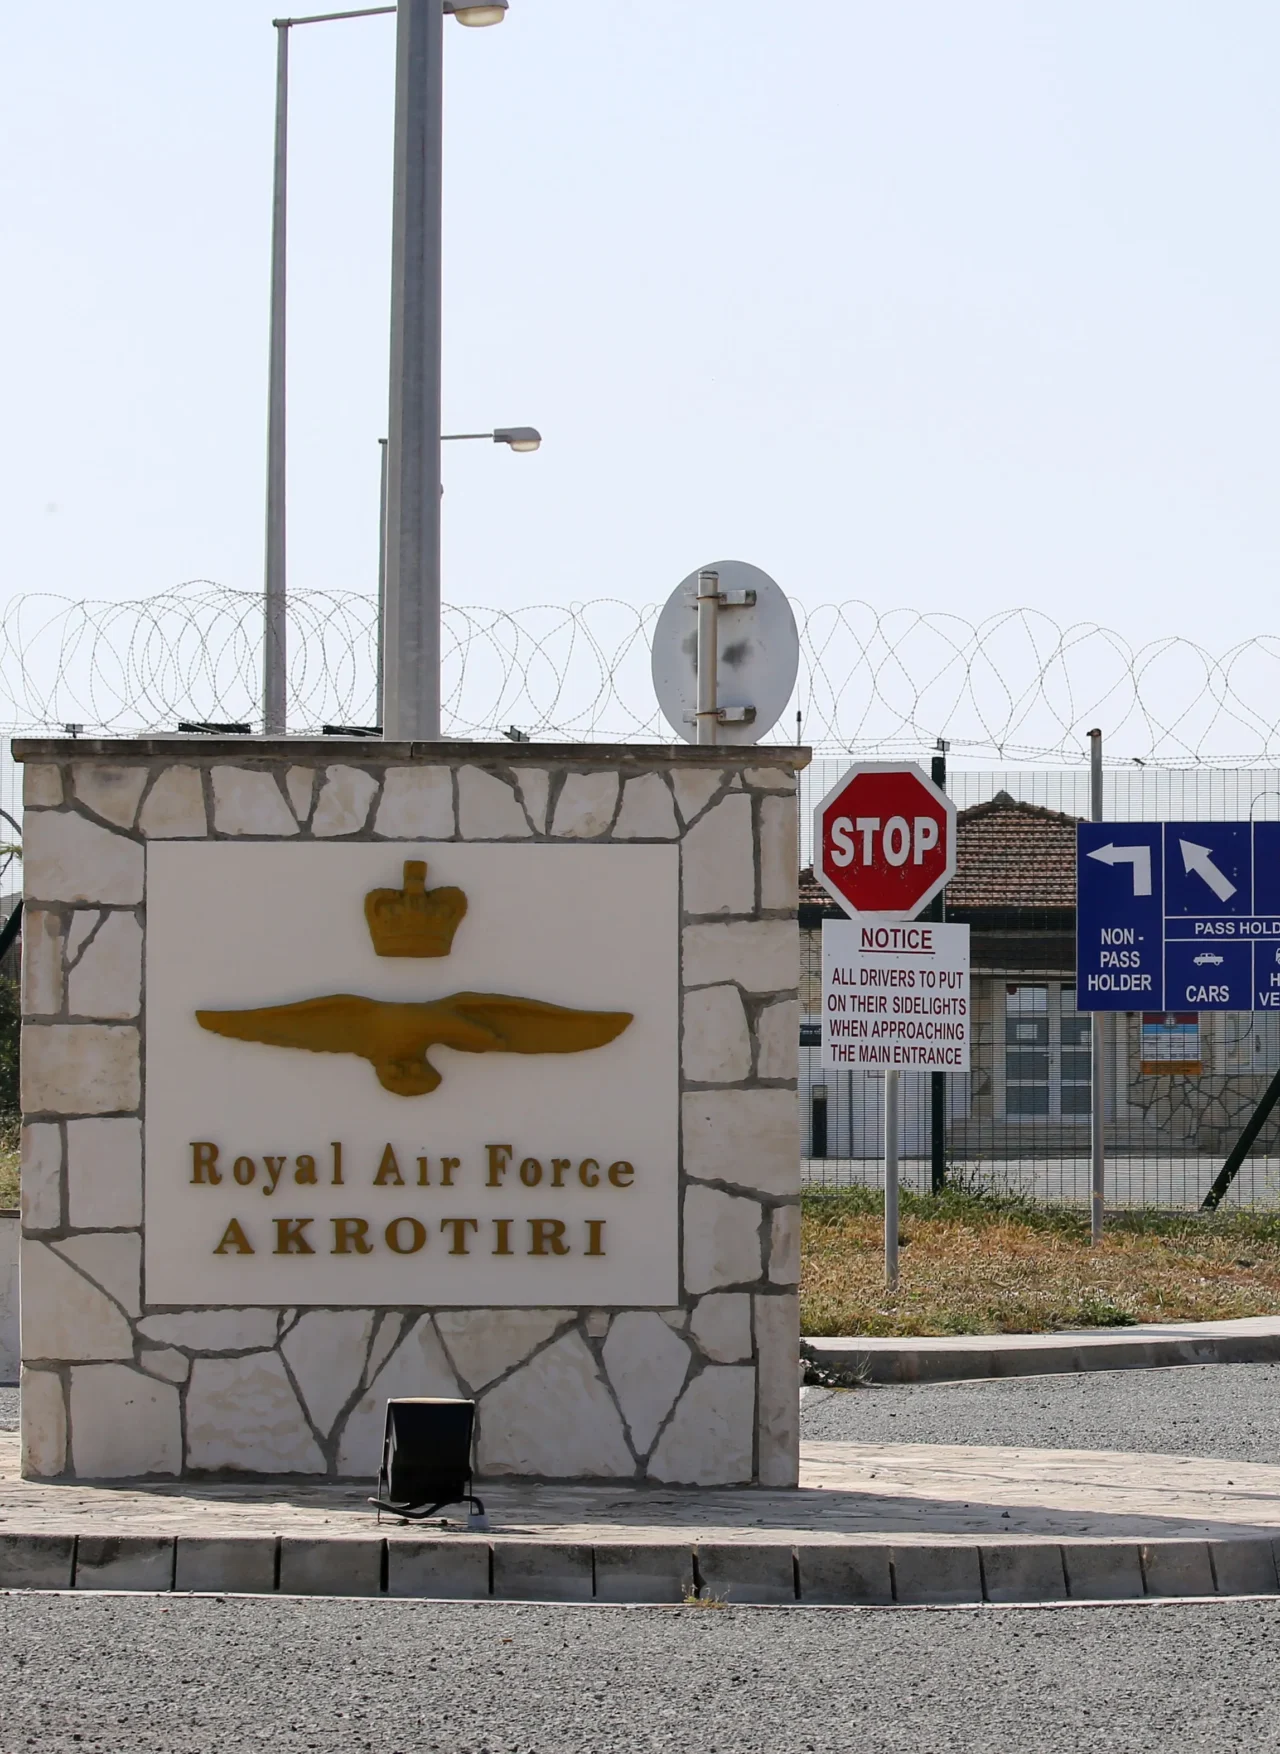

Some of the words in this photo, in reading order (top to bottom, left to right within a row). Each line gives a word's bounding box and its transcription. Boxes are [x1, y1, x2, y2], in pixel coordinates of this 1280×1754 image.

[831, 815, 938, 867] STOP
[861, 928, 932, 950] NOTICE
[1101, 928, 1134, 945] NON
[1195, 921, 1235, 935] PASS
[1100, 951, 1140, 968] PASS
[832, 967, 857, 986] ALL
[860, 968, 915, 988] DRIVERS
[919, 970, 936, 988] TO
[939, 972, 963, 989] PUT
[1088, 974, 1152, 991] HOLDER
[1186, 985, 1230, 1002] CARS
[827, 994, 846, 1012] ON
[850, 995, 888, 1014] THEIR
[892, 996, 967, 1016] SIDELIGHTS
[829, 1018, 868, 1037] WHEN
[871, 1020, 965, 1041] APPROACHING
[831, 1044, 856, 1062] THE
[859, 1045, 890, 1063] MAIN
[893, 1046, 962, 1065] ENTRANCE
[189, 1141, 344, 1196] Royal
[373, 1142, 461, 1187] Air
[485, 1144, 636, 1188] Force
[213, 1217, 607, 1256] AKROTIRI
